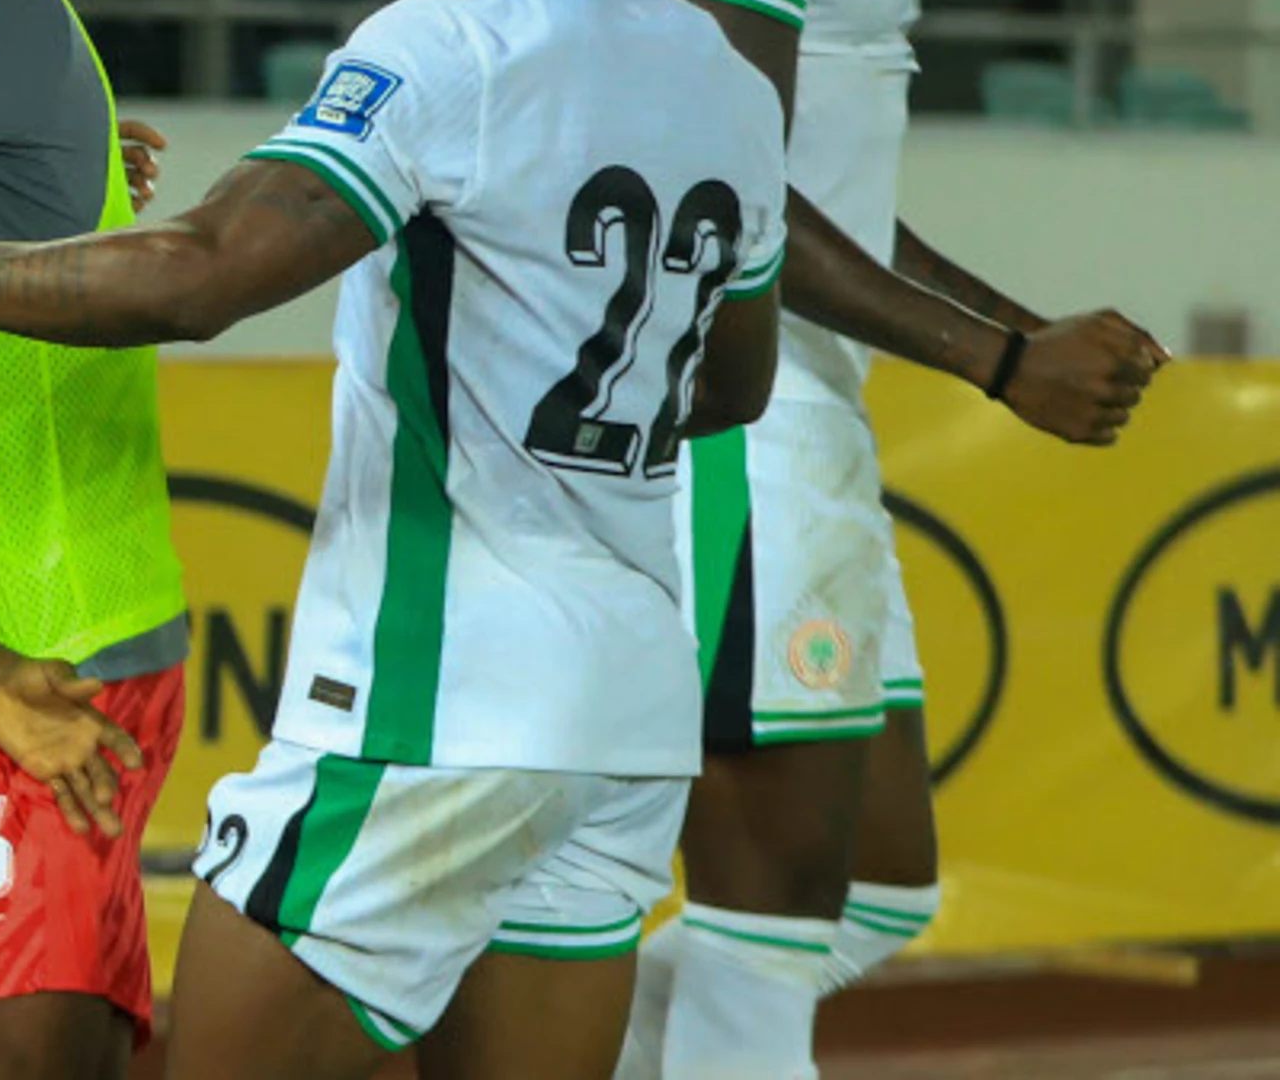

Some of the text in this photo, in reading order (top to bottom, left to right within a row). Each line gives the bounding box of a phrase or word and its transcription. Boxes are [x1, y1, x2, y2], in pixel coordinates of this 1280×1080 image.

[524, 164, 744, 480] 22
[183, 604, 291, 748] N
[204, 810, 248, 886] 2
